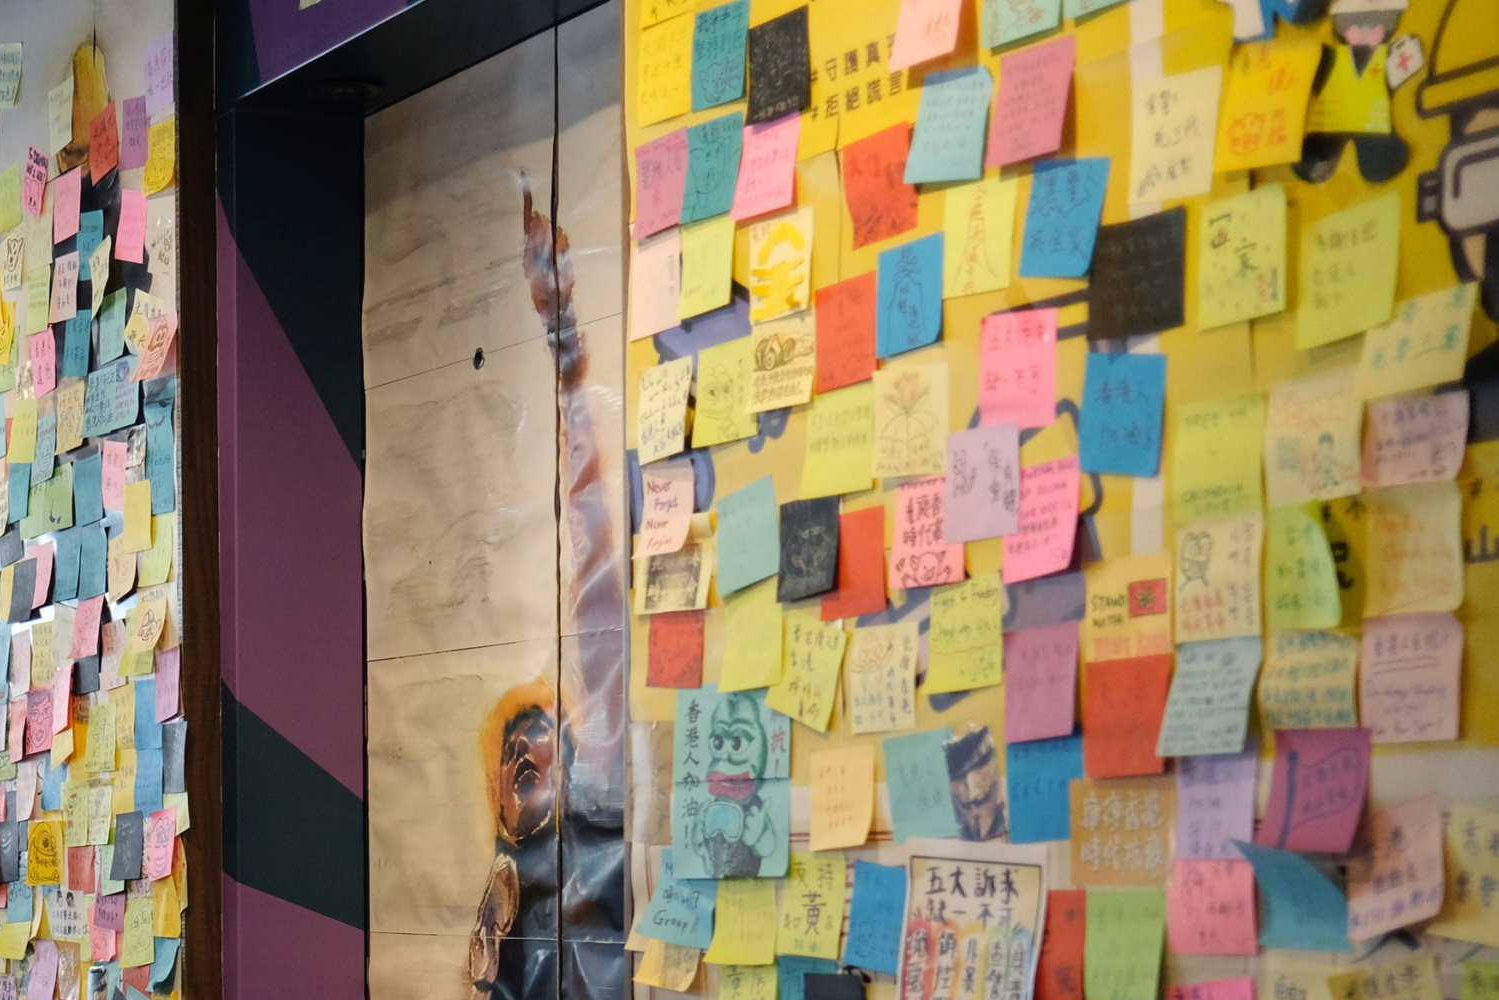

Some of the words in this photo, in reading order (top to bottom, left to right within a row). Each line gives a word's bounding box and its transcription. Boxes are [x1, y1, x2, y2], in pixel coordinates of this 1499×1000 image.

[647, 479, 672, 495] Never
[681, 698, 703, 849] 香港人加油!
[794, 862, 835, 890] 支持
[926, 866, 1018, 904] 五大訴求
[802, 891, 826, 935] 黃
[926, 899, 1015, 937] 缺一不可
